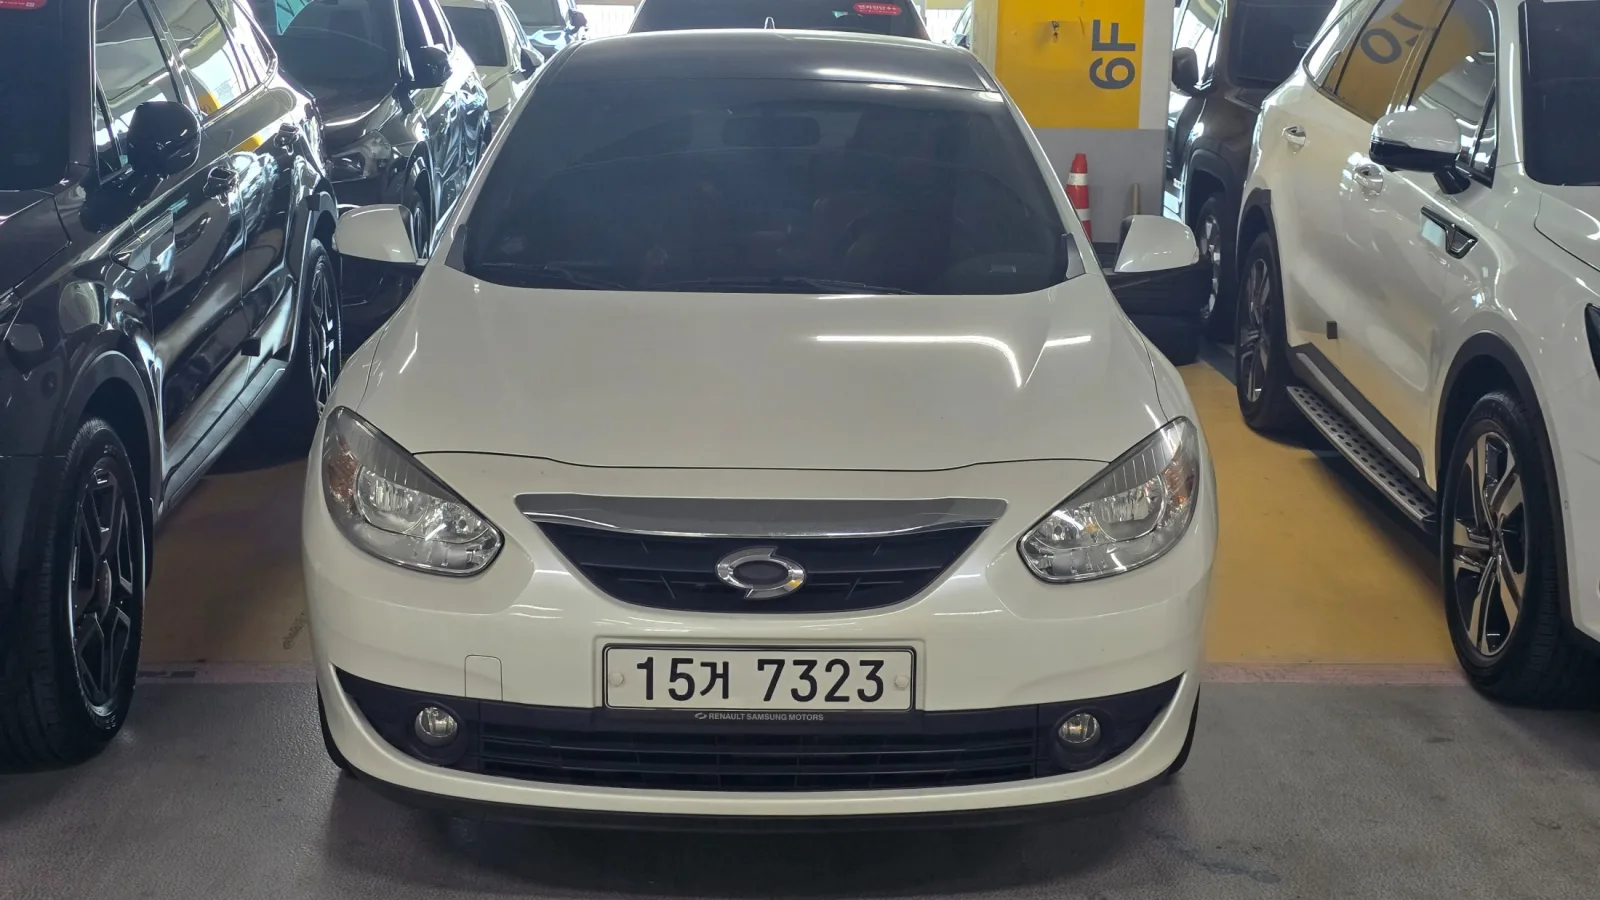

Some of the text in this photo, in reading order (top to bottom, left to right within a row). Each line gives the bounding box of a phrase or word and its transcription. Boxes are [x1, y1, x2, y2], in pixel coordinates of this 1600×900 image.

[1089, 19, 1136, 90] 6F
[636, 656, 885, 703] 15거 7323
[708, 712, 824, 721] RENAULT SAMSUNG MOTORS
